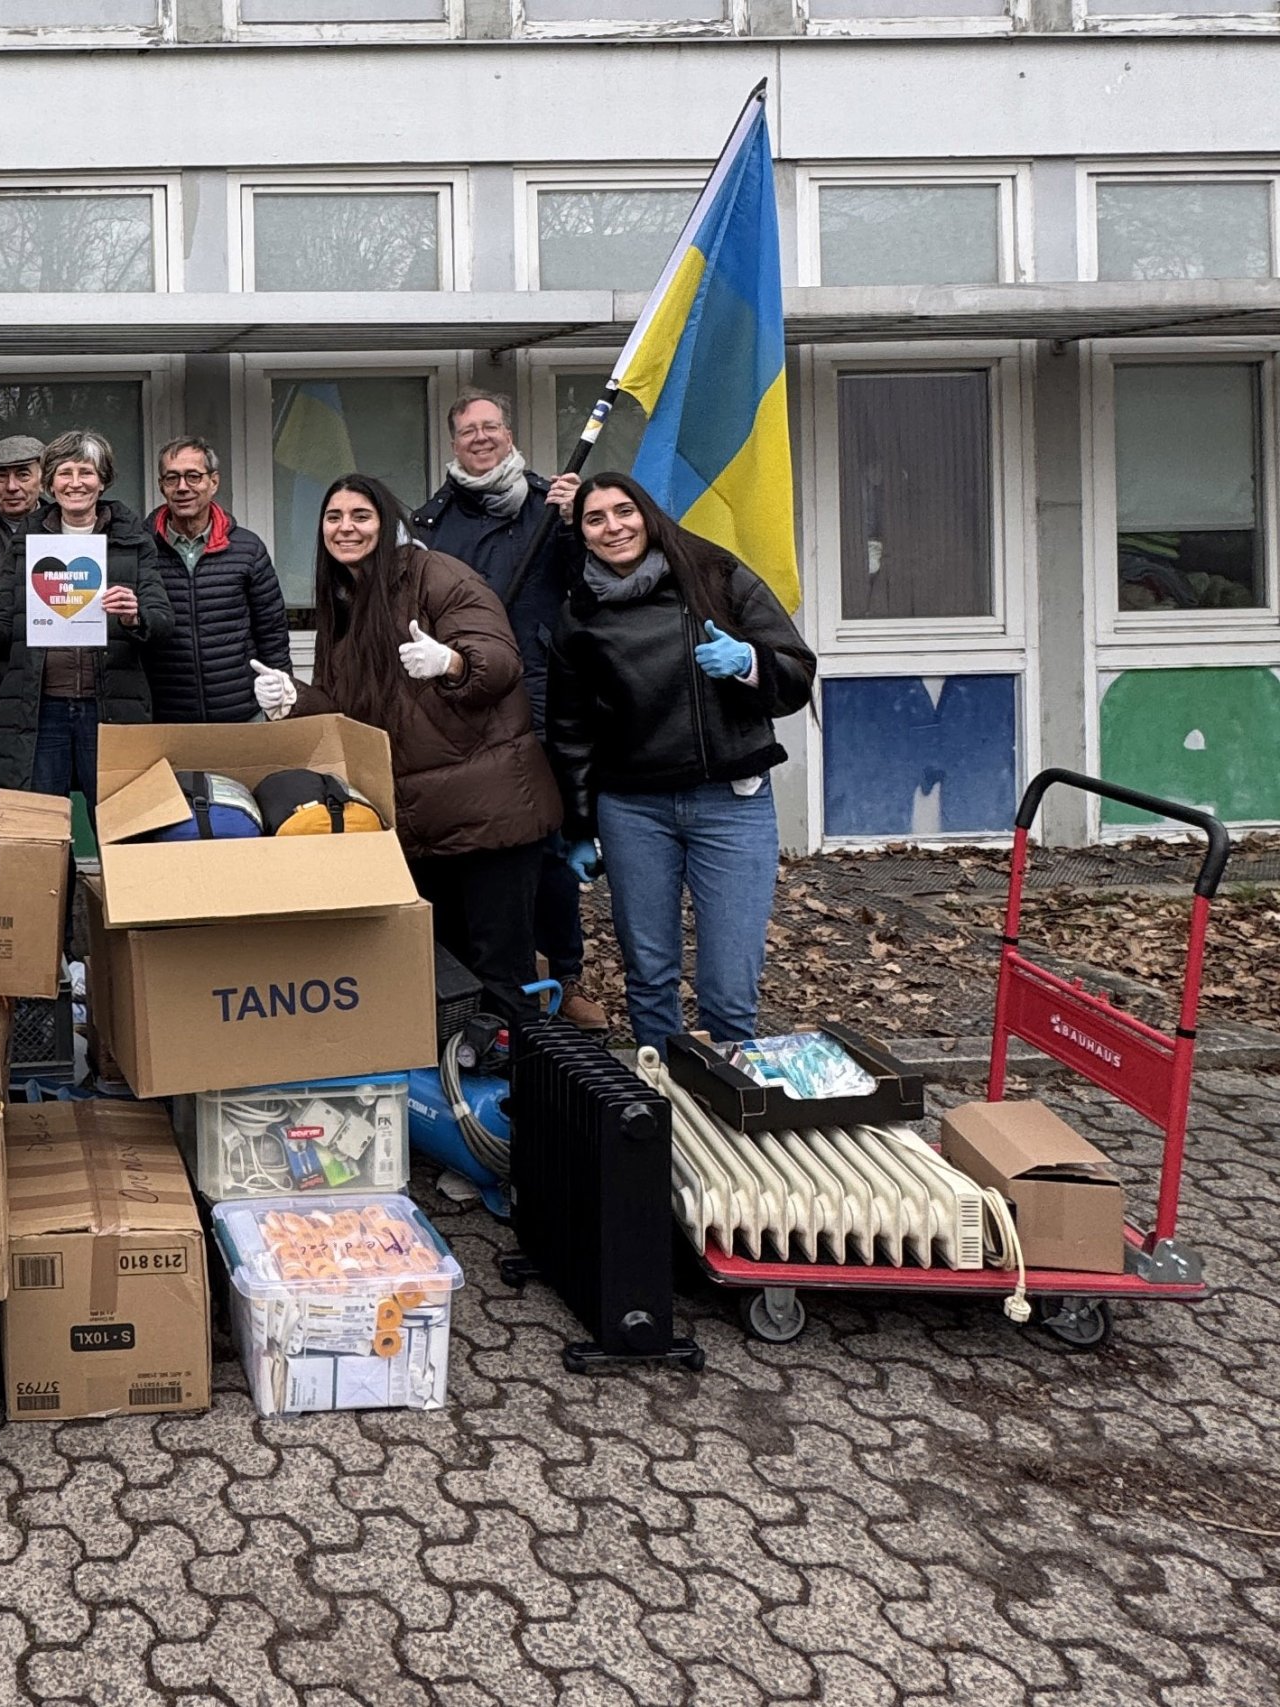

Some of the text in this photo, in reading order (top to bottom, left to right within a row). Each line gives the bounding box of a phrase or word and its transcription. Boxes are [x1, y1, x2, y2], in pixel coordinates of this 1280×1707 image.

[43, 571, 89, 580] FRANKFURT
[49, 596, 83, 604] UKRAINE
[212, 976, 360, 1022] TANOS
[1061, 1025, 1121, 1068] BAUHAUS
[120, 1254, 182, 1269] 213 810
[16, 1381, 60, 1394] 37793
